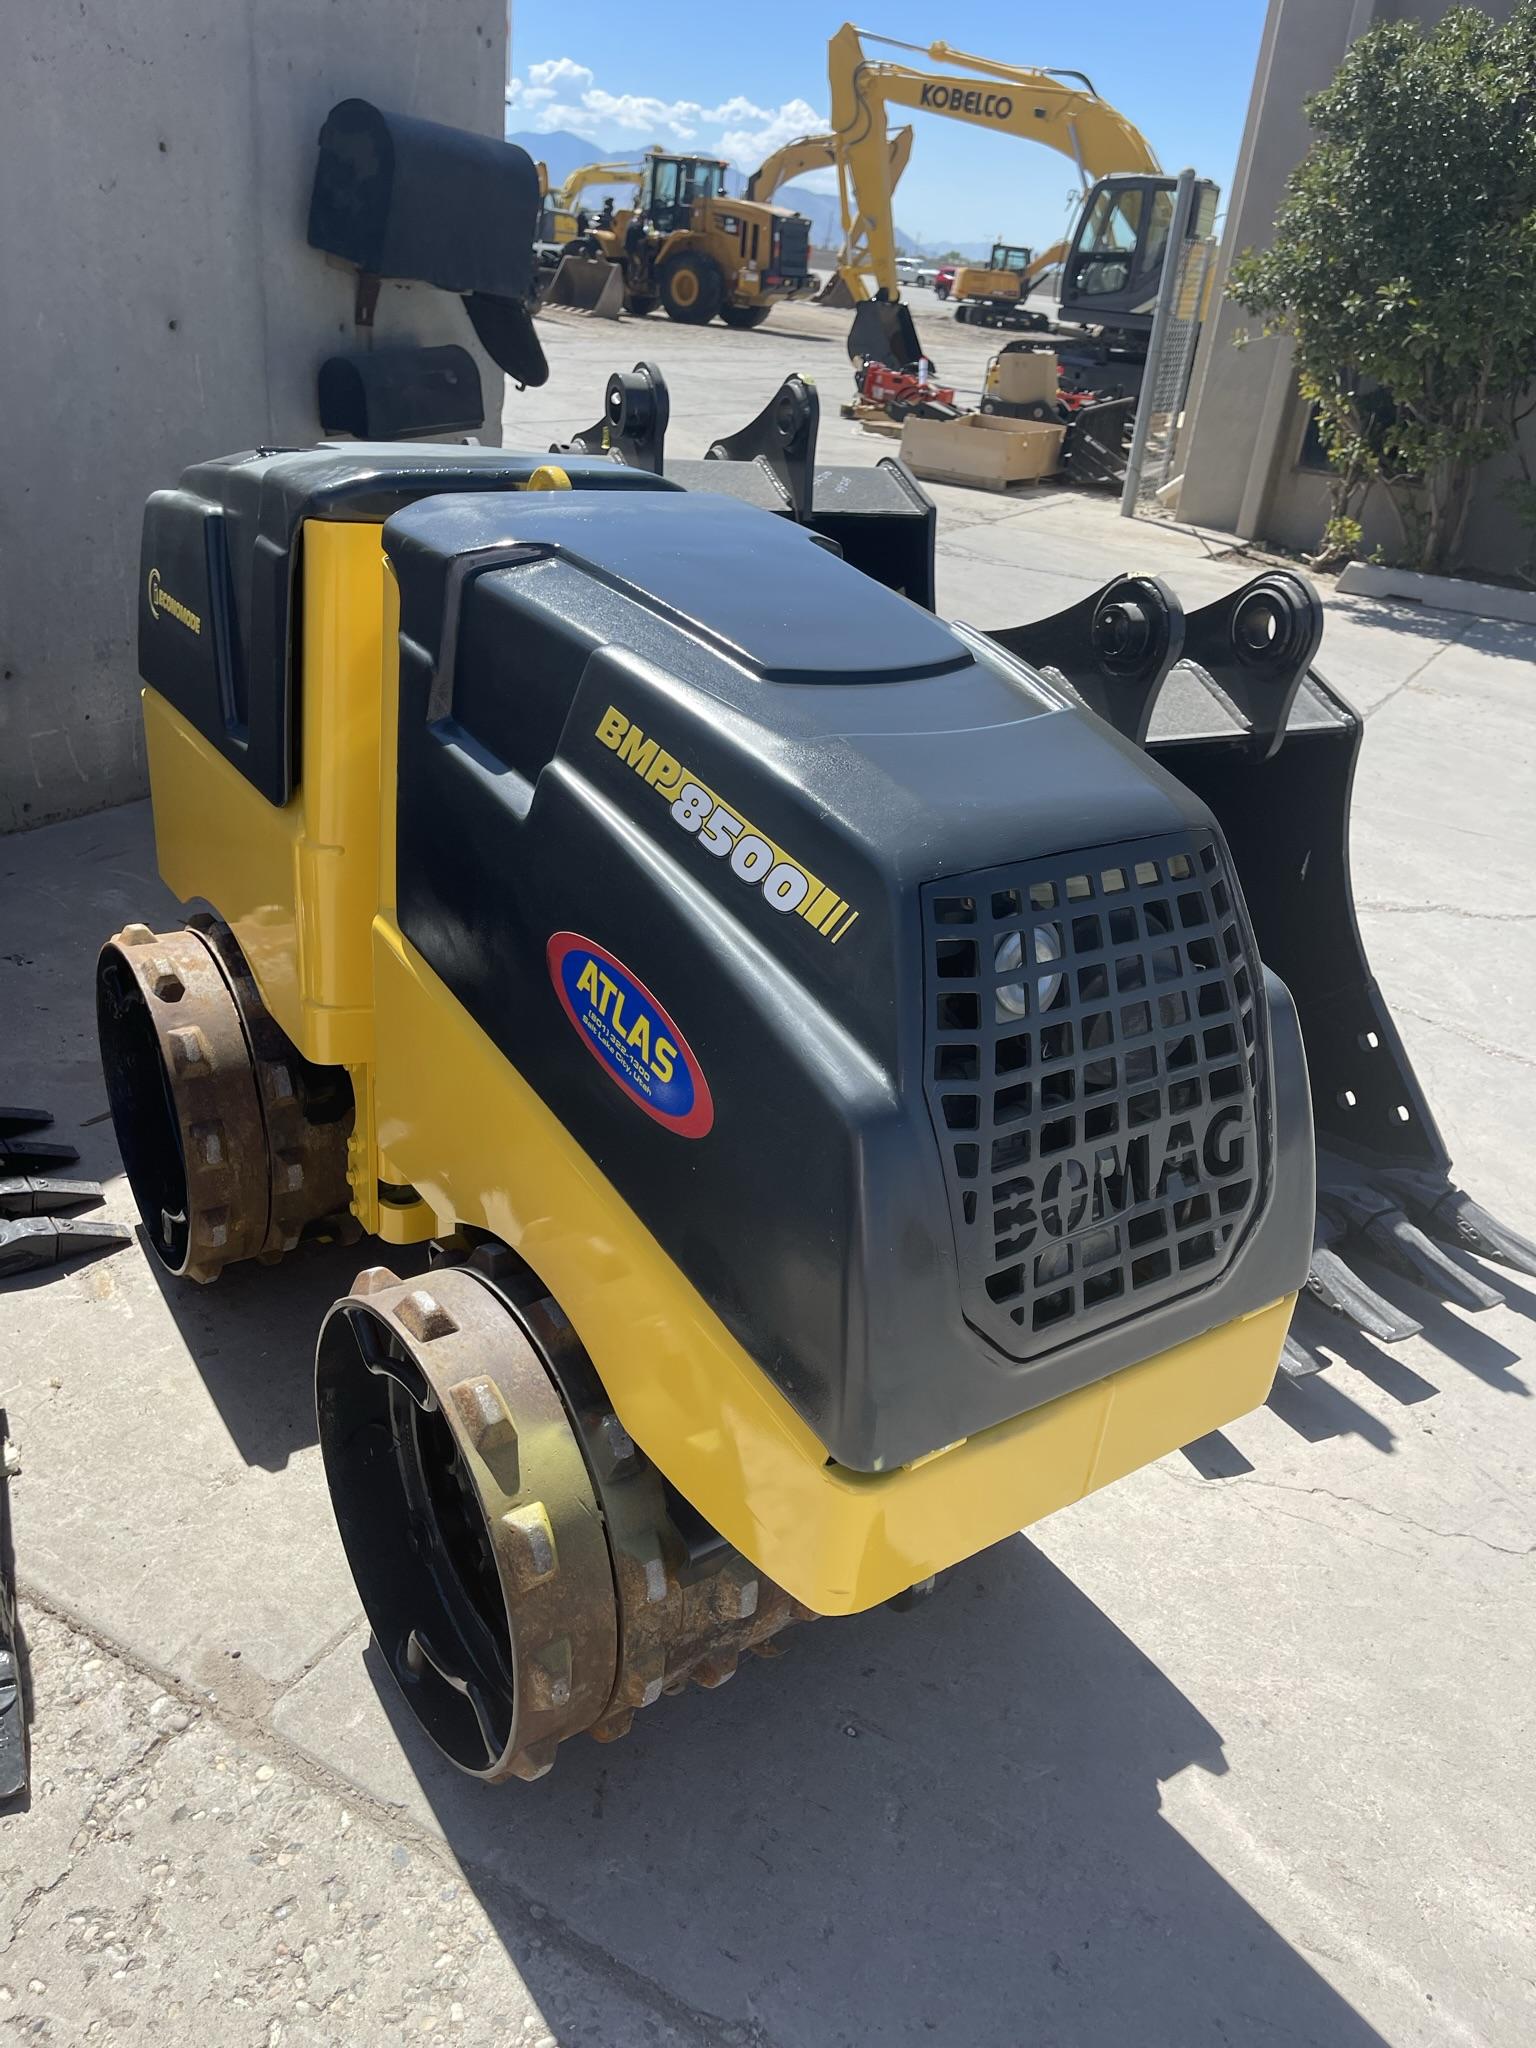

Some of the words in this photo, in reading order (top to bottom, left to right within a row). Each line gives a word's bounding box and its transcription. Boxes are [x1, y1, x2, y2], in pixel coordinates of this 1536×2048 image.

[920, 83, 1013, 119] KOBELCO
[576, 959, 678, 1083] ATLAS
[582, 1014, 598, 1035] Salt
[597, 1031, 615, 1054] Lake
[615, 1051, 632, 1076] City,
[633, 1071, 652, 1096] Utah
[588, 1009, 610, 1037] (801)
[609, 1033, 651, 1082] 322-1300
[992, 1105, 1244, 1262] BOMAG
